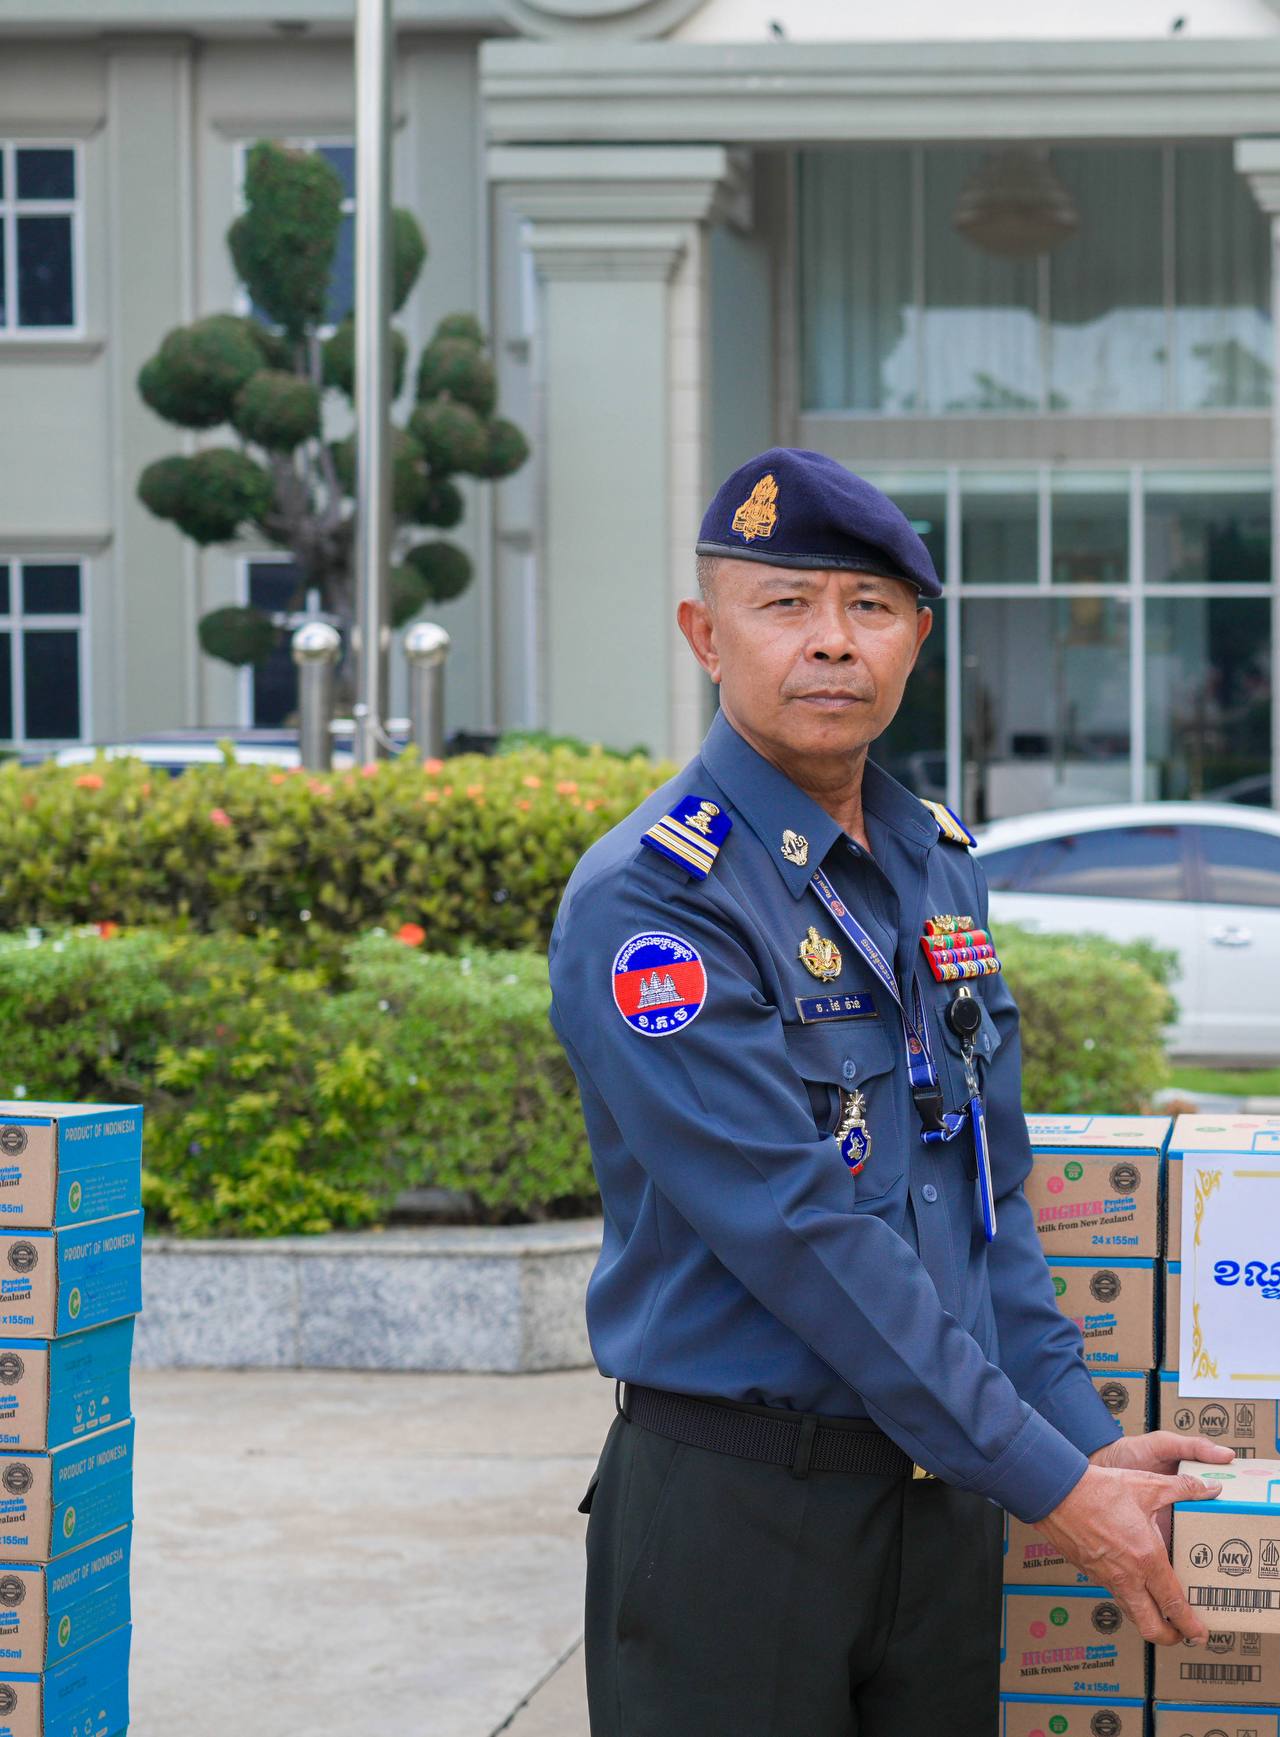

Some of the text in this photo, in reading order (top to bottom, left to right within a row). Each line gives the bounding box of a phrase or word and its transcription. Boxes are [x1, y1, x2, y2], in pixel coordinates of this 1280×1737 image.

[65, 1125, 94, 1141] PRODUCT
[103, 1119, 135, 1136] INDONESIA
[0, 1204, 23, 1213] 55ml
[1038, 1200, 1103, 1223] HIGHER
[1037, 1213, 1134, 1233] Milk from New Zealand
[1092, 1235, 1103, 1244] 24
[64, 1242, 92, 1262] PRODUCT
[103, 1233, 135, 1252] INDONESIA
[1082, 1327, 1113, 1338] ealand
[1202, 1416, 1226, 1427] NKV
[59, 1458, 87, 1482] PRODUCT
[97, 1444, 127, 1466] INDONESIA
[1023, 1558, 1064, 1569] Milk from
[1221, 1552, 1249, 1567] NKV
[53, 1568, 81, 1594] PRODUCT
[91, 1548, 123, 1574] INDONESIA
[1208, 1633, 1231, 1644] NKV
[0, 1649, 21, 1659] 55ml
[1021, 1646, 1086, 1666] HIGHER
[1020, 1659, 1114, 1677] Milk from New Zealand
[1073, 1681, 1086, 1691] 24
